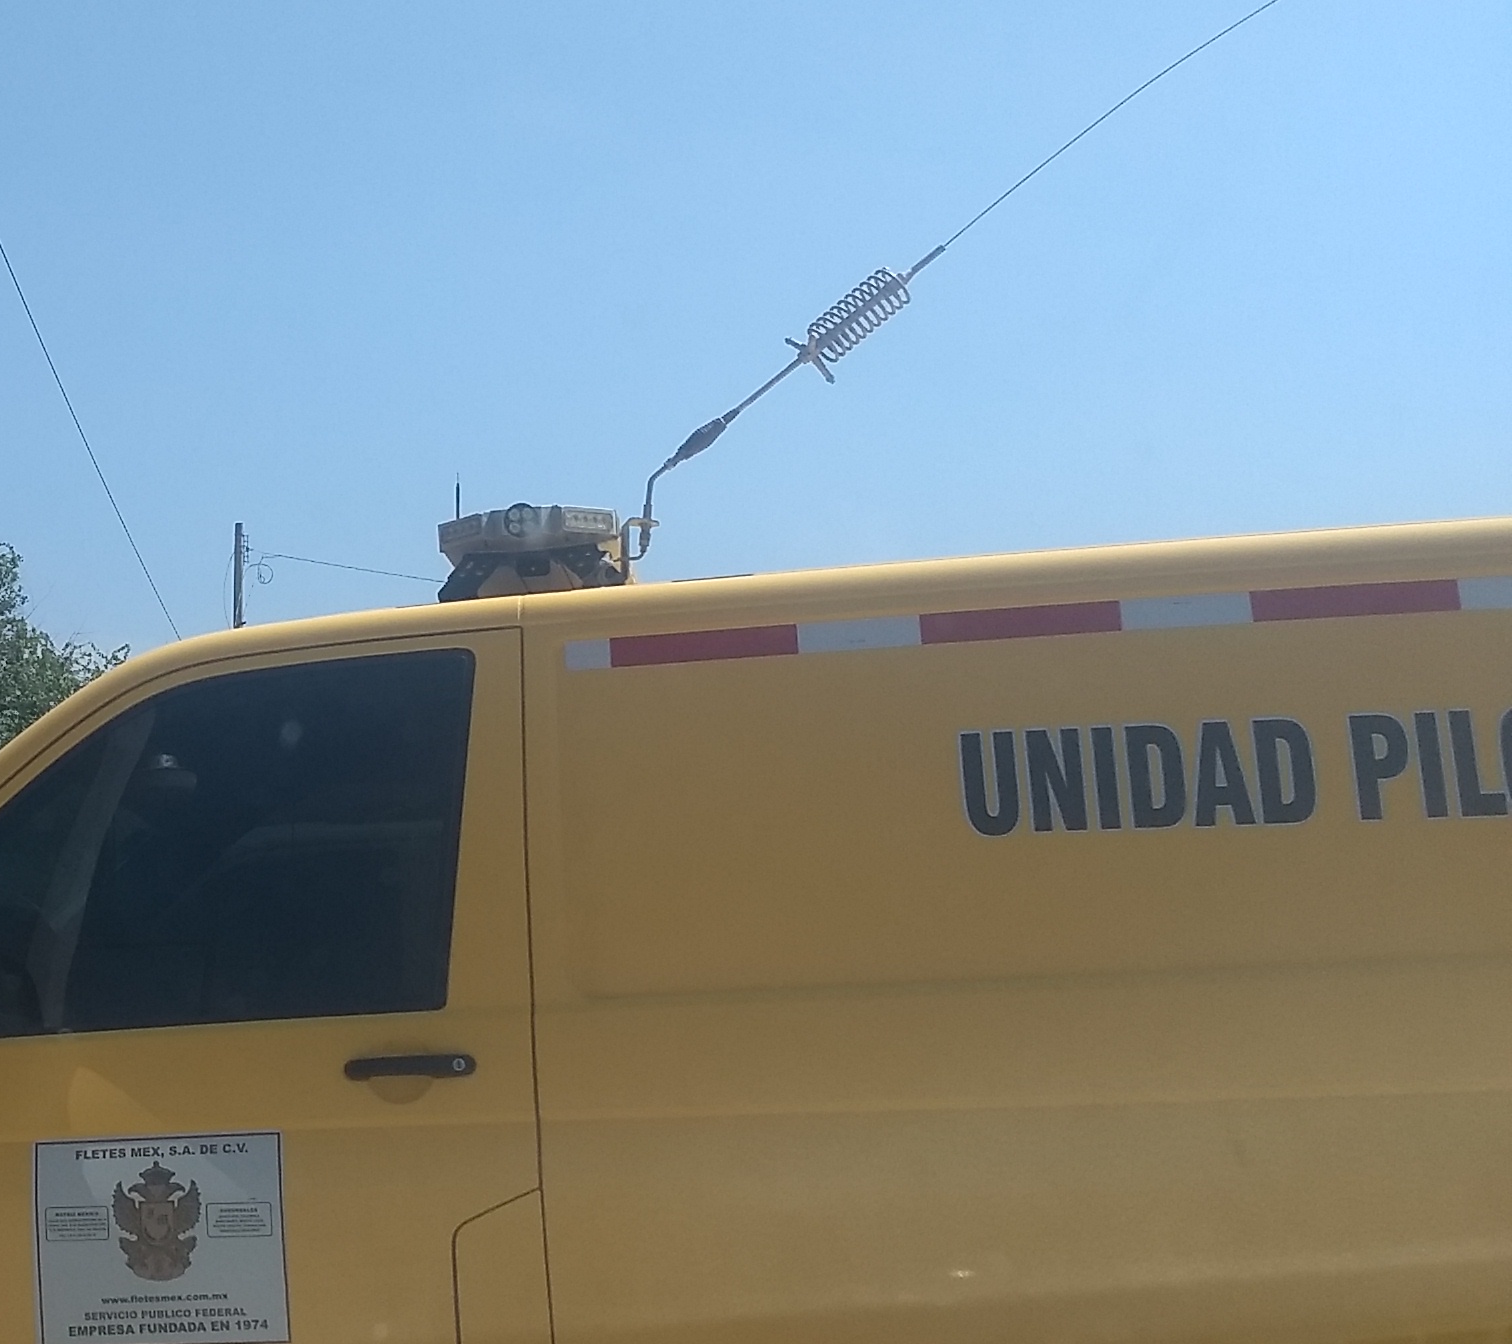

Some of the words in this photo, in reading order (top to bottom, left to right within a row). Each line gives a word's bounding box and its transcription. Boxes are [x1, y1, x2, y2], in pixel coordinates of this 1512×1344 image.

[959, 717, 1317, 837] UNIDAD
[1346, 706, 1512, 822] PIL
[75, 1148, 126, 1160] FLETES
[130, 1146, 165, 1158] MEX,
[169, 1145, 196, 1156] S.A.
[199, 1144, 218, 1155] DE
[222, 1142, 249, 1154] C.V.
[101, 1293, 228, 1305] www.fletesmex.com.mx
[84, 1310, 138, 1321] SERVICIO
[195, 1307, 247, 1318] FEDERAL
[68, 1324, 135, 1337] EMPRESA
[139, 1321, 206, 1334] FUNDADA
[210, 1320, 231, 1332] EN
[235, 1319, 268, 1331] 1974
